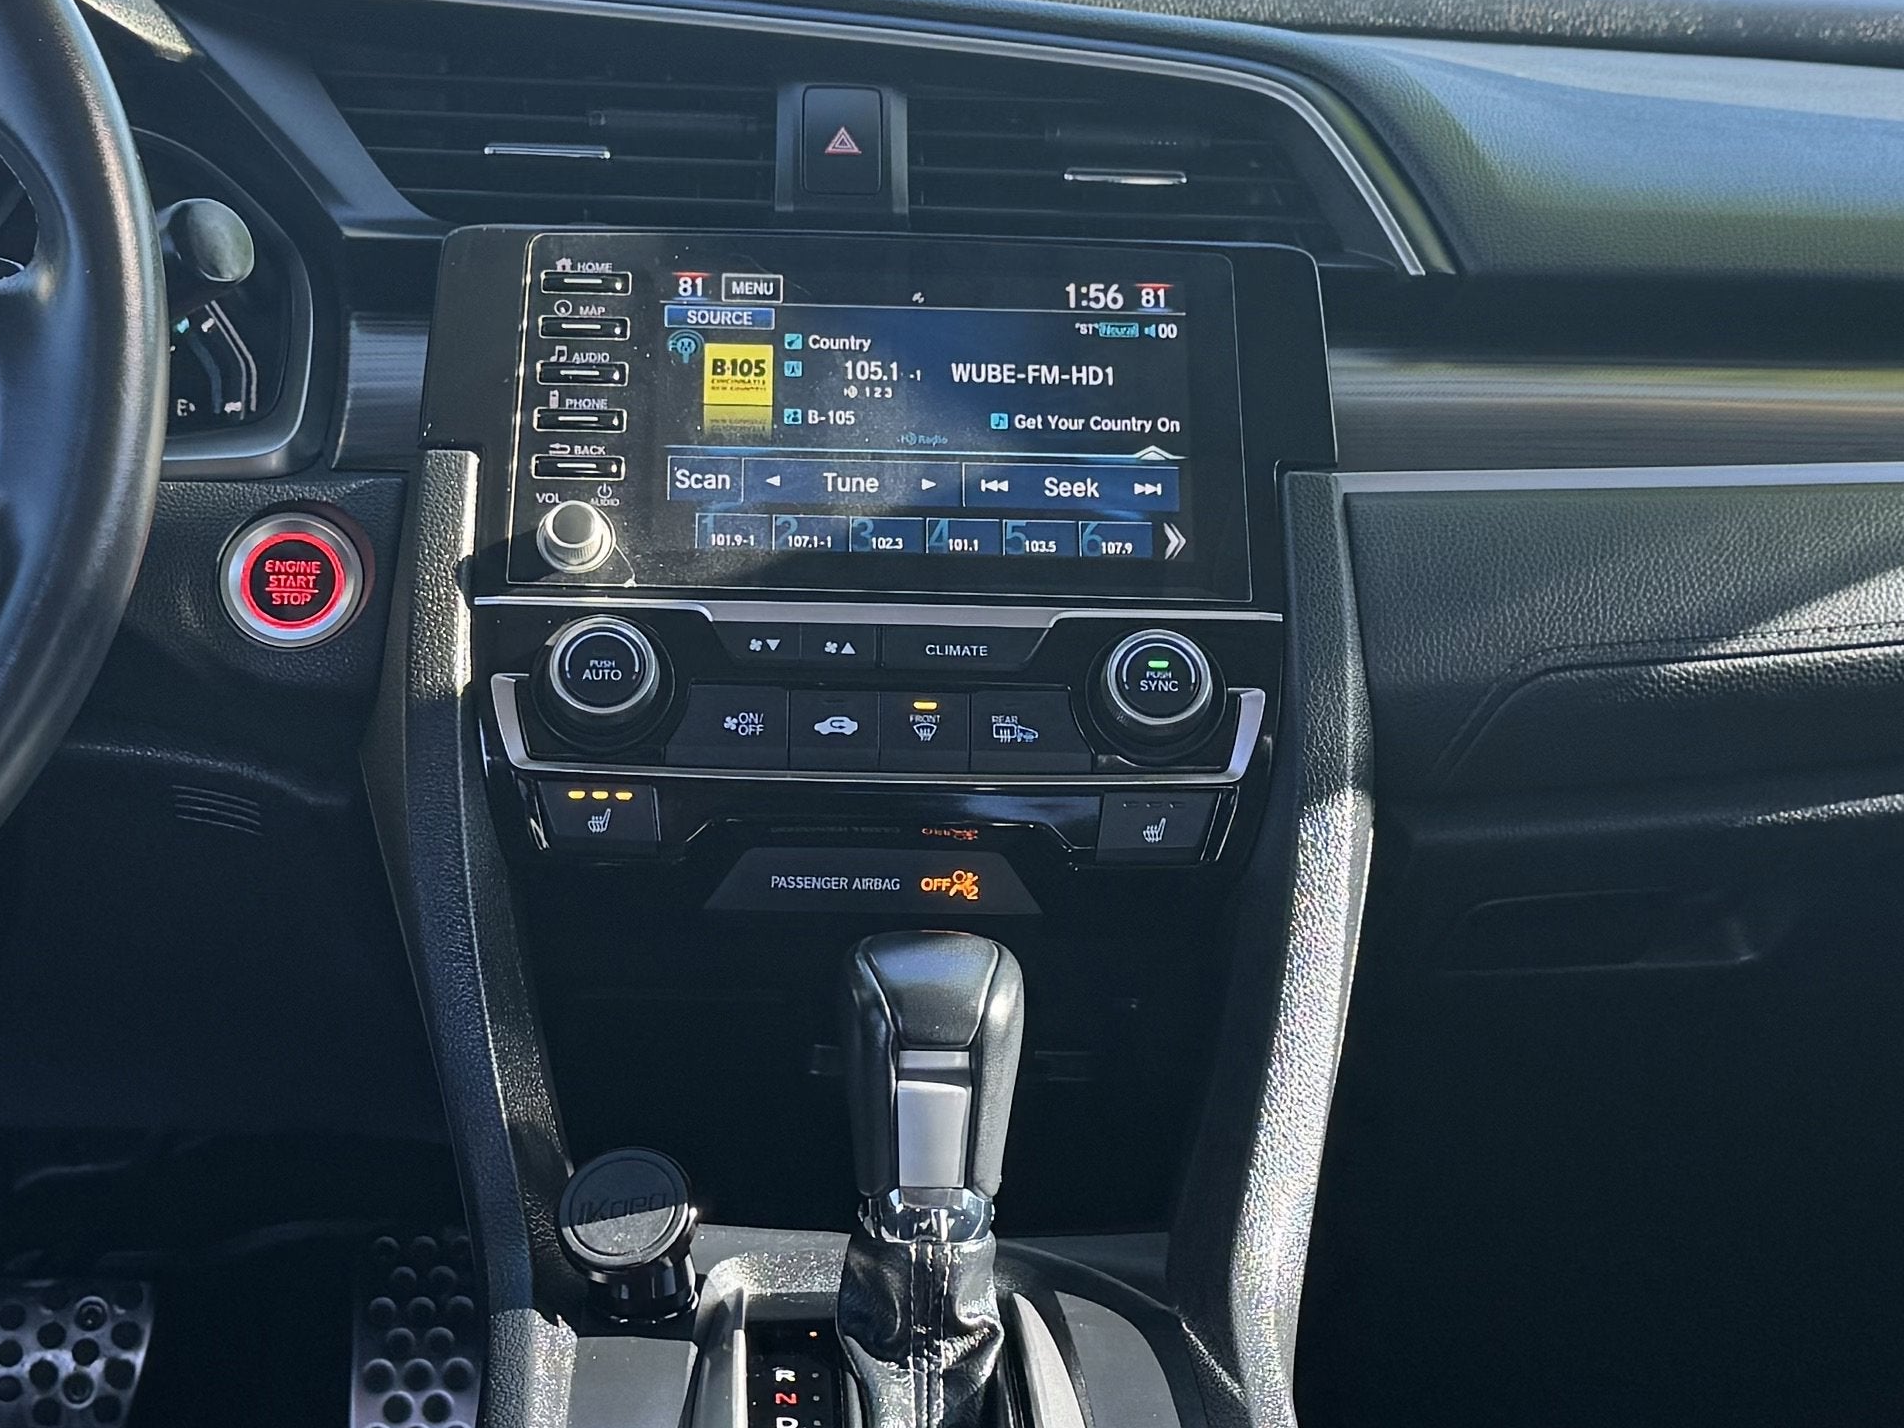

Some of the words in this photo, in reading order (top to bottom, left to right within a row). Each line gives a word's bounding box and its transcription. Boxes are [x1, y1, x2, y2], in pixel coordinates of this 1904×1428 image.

[577, 262, 613, 272] HOME
[678, 277, 704, 297] 81
[731, 280, 774, 296] MENU
[1065, 282, 1124, 310] 1:56
[1141, 287, 1166, 308] 81
[579, 305, 606, 316] MAP
[687, 310, 753, 326] SOURCE
[1157, 322, 1178, 339] 00
[808, 335, 872, 352] Country
[572, 352, 610, 363] AUDIO
[845, 360, 898, 381] 105.1
[951, 362, 1114, 387] WUBE-FM-HD1
[566, 398, 608, 409] PHONE
[807, 410, 855, 425] B-105
[1014, 415, 1042, 431] Get
[1047, 415, 1085, 431] Your
[1090, 416, 1152, 435] Country
[1157, 417, 1180, 433] On
[574, 445, 606, 455] BACK
[675, 469, 731, 490] Scan
[823, 472, 880, 493] Tune
[1044, 477, 1100, 498] Seek
[536, 492, 562, 504] VOL
[590, 497, 620, 507] AUDIO
[710, 533, 755, 547] 101.9-1
[787, 535, 832, 549] 107.1-1
[871, 537, 903, 550] 102.3
[948, 538, 979, 552] 101.1
[1025, 539, 1057, 553] 103.5
[1101, 541, 1133, 555] 107.9
[264, 559, 321, 574] ENGINE
[269, 575, 317, 589] START
[271, 592, 311, 606] STOP
[925, 644, 988, 657] CLIMATE
[589, 660, 616, 668] PUSH
[582, 669, 622, 681] AUTO
[1146, 671, 1172, 679] PUSH
[1140, 679, 1179, 692] SYNC
[738, 712, 764, 725] ON/
[909, 715, 941, 723] FRONT
[991, 715, 1018, 723] REAR
[738, 725, 764, 736] OFF
[771, 876, 848, 891] PASSENGER
[852, 877, 901, 891] AIRBAG
[920, 878, 950, 891] OFF
[775, 1369, 796, 1382] R
[775, 1393, 798, 1404] N
